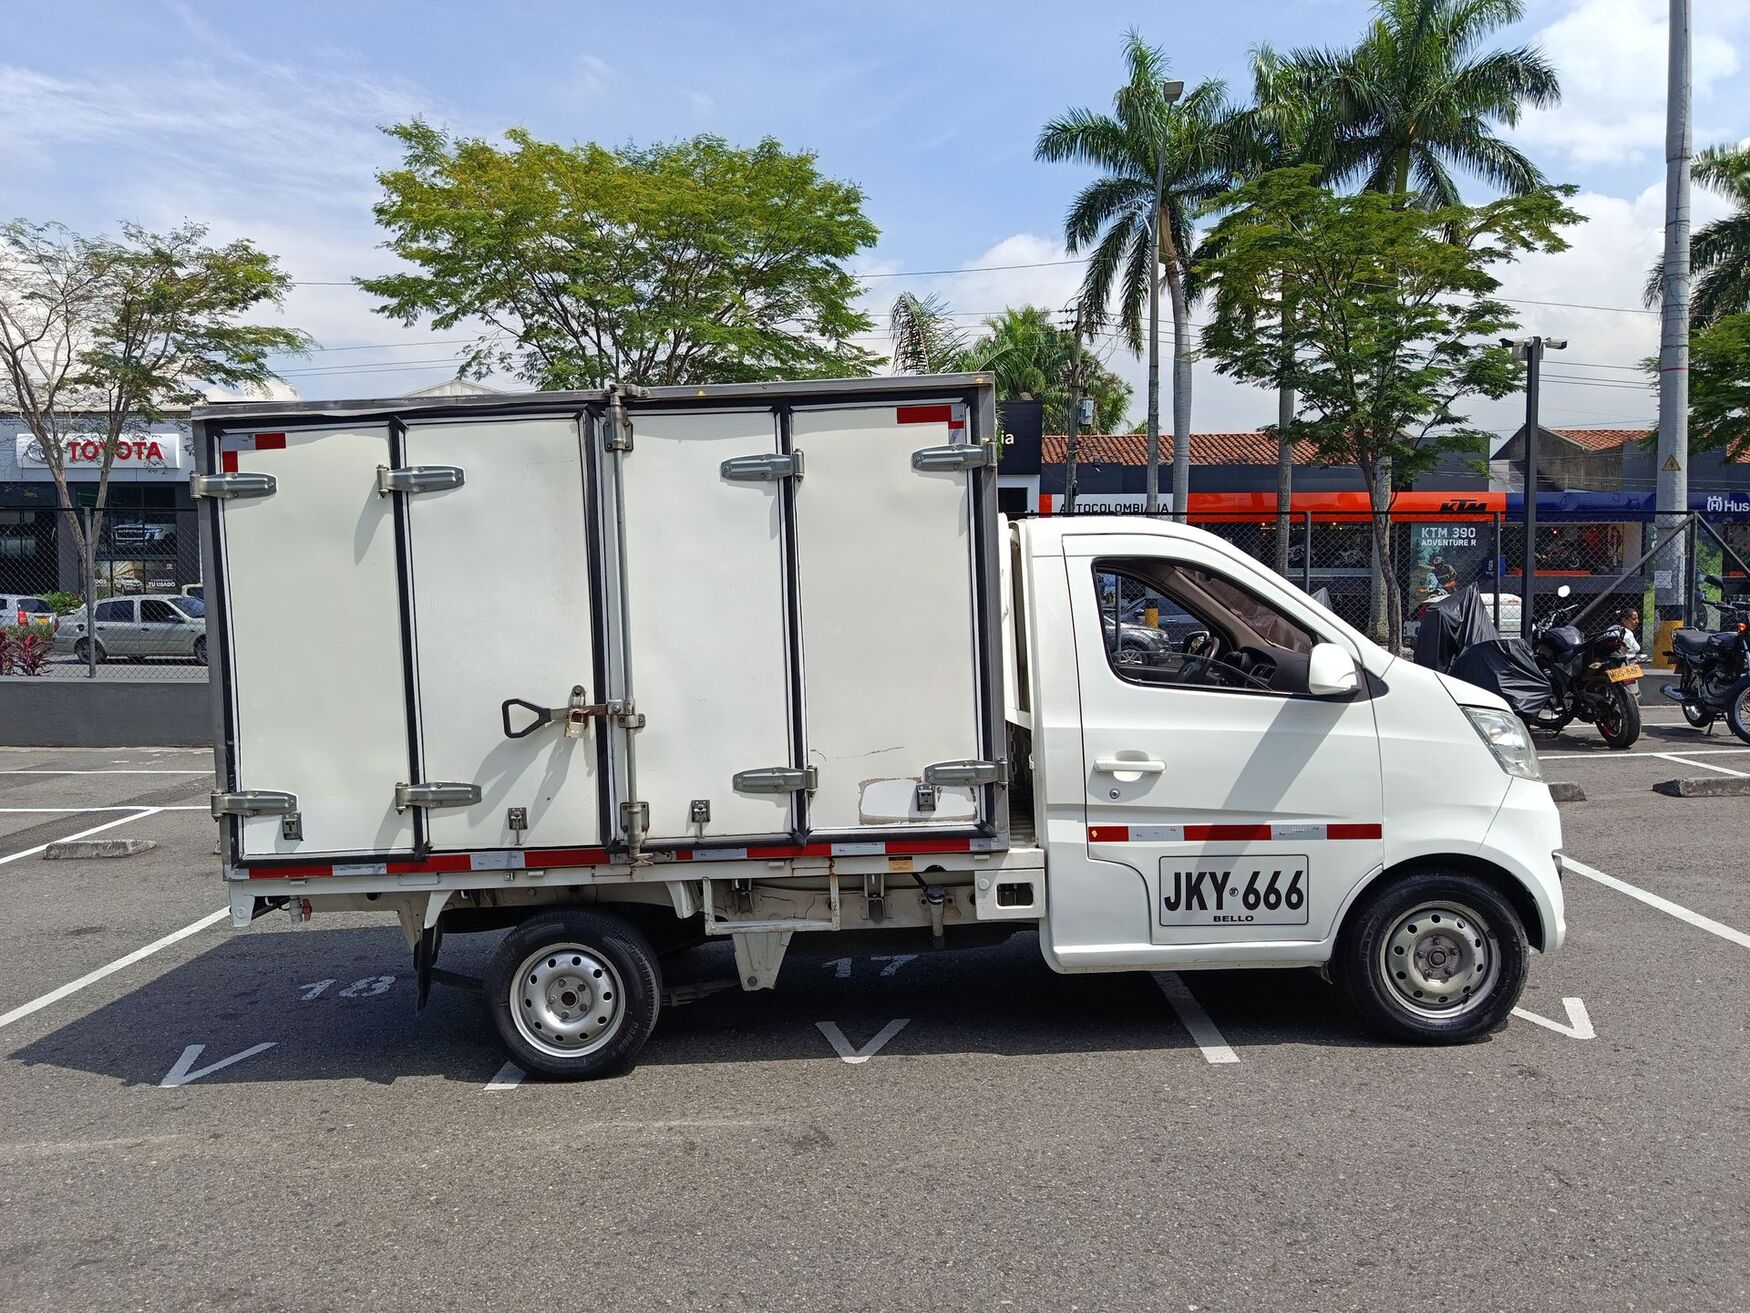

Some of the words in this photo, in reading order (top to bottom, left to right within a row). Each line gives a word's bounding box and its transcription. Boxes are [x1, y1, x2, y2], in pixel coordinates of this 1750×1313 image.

[67, 440, 164, 460] TOOTA
[1060, 503, 1169, 514] ATOCOLOMBIA
[1440, 499, 1488, 512] KTM
[1421, 527, 1448, 538] KTM
[1452, 527, 1476, 538] 390
[1164, 871, 1231, 911] JKY
[1242, 870, 1304, 911] 666
[1213, 915, 1254, 923] BELLO
